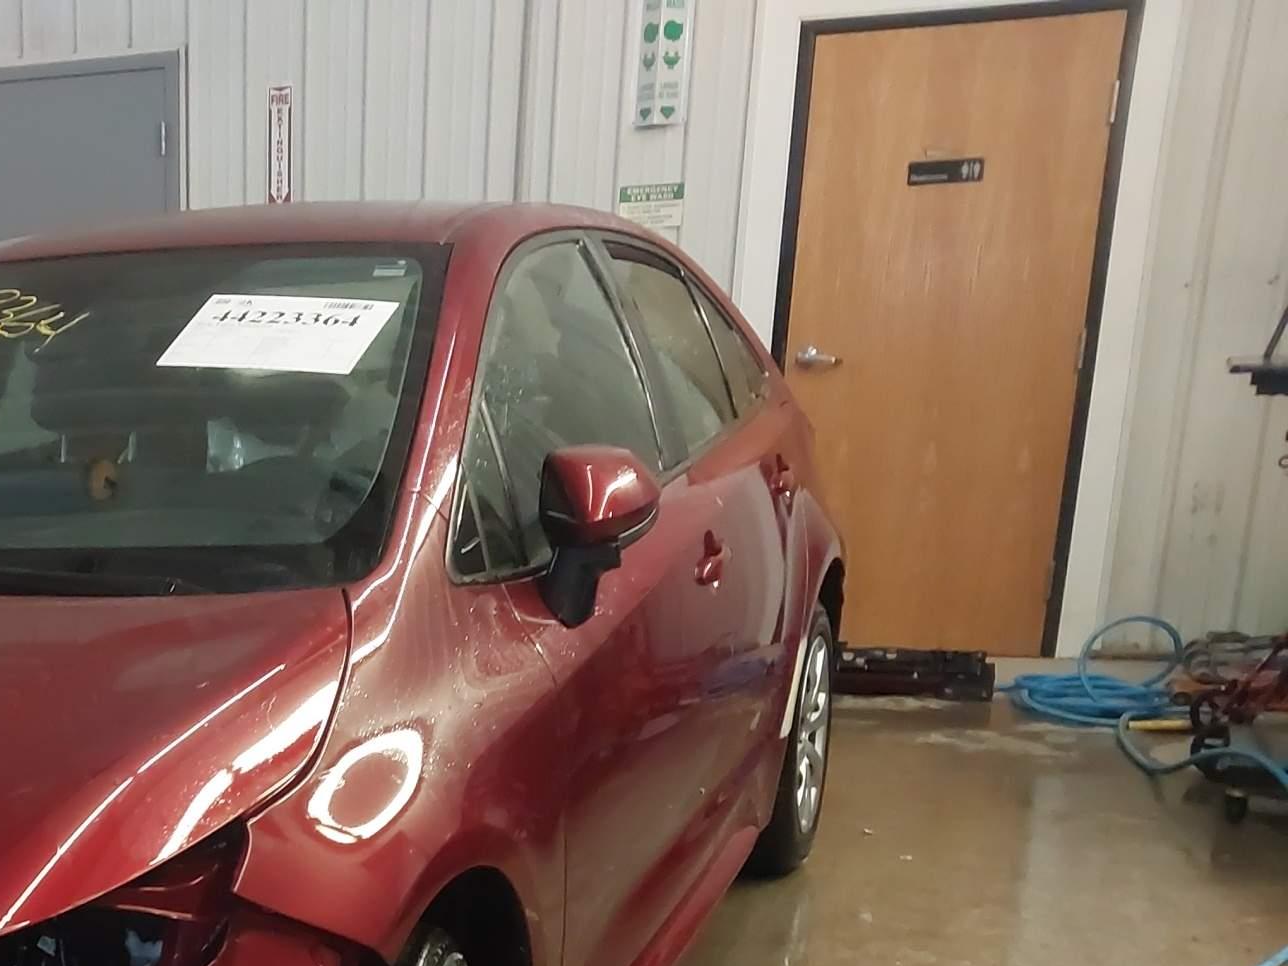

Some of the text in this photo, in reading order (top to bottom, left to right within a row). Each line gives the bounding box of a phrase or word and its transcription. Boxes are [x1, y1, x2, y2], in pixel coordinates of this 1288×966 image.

[270, 93, 289, 105] FIRE
[626, 185, 679, 195] EMERGENCY
[631, 192, 675, 202] EYE WASH
[211, 308, 361, 327] 44223364
